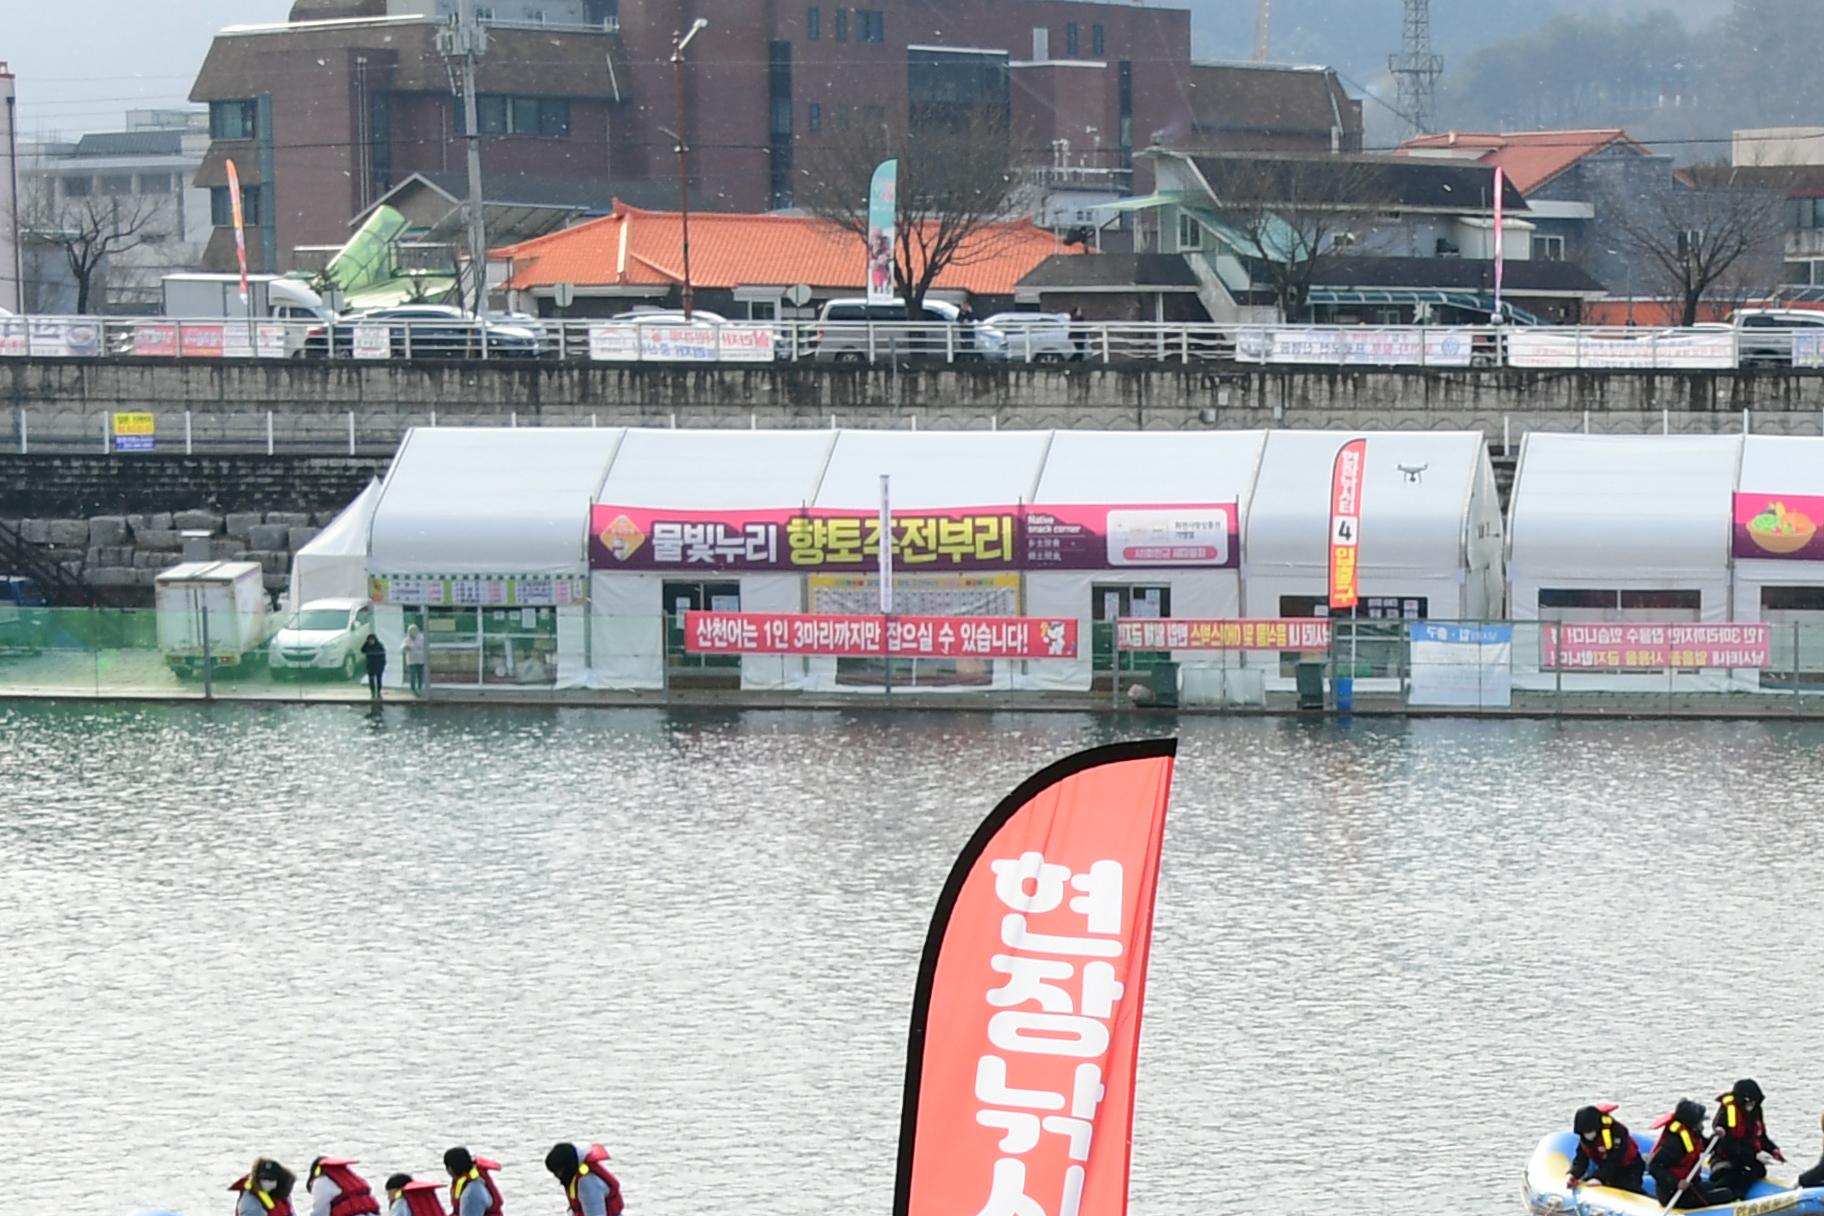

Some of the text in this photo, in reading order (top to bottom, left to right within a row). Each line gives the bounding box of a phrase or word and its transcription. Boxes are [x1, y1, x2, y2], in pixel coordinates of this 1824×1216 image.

[651, 515, 1013, 565] 물빛누리 향토주전부리
[1338, 519, 1353, 541] 4
[696, 617, 1029, 652] 산천어는 1인 3마리까지만 잡으실 수 있습니다!
